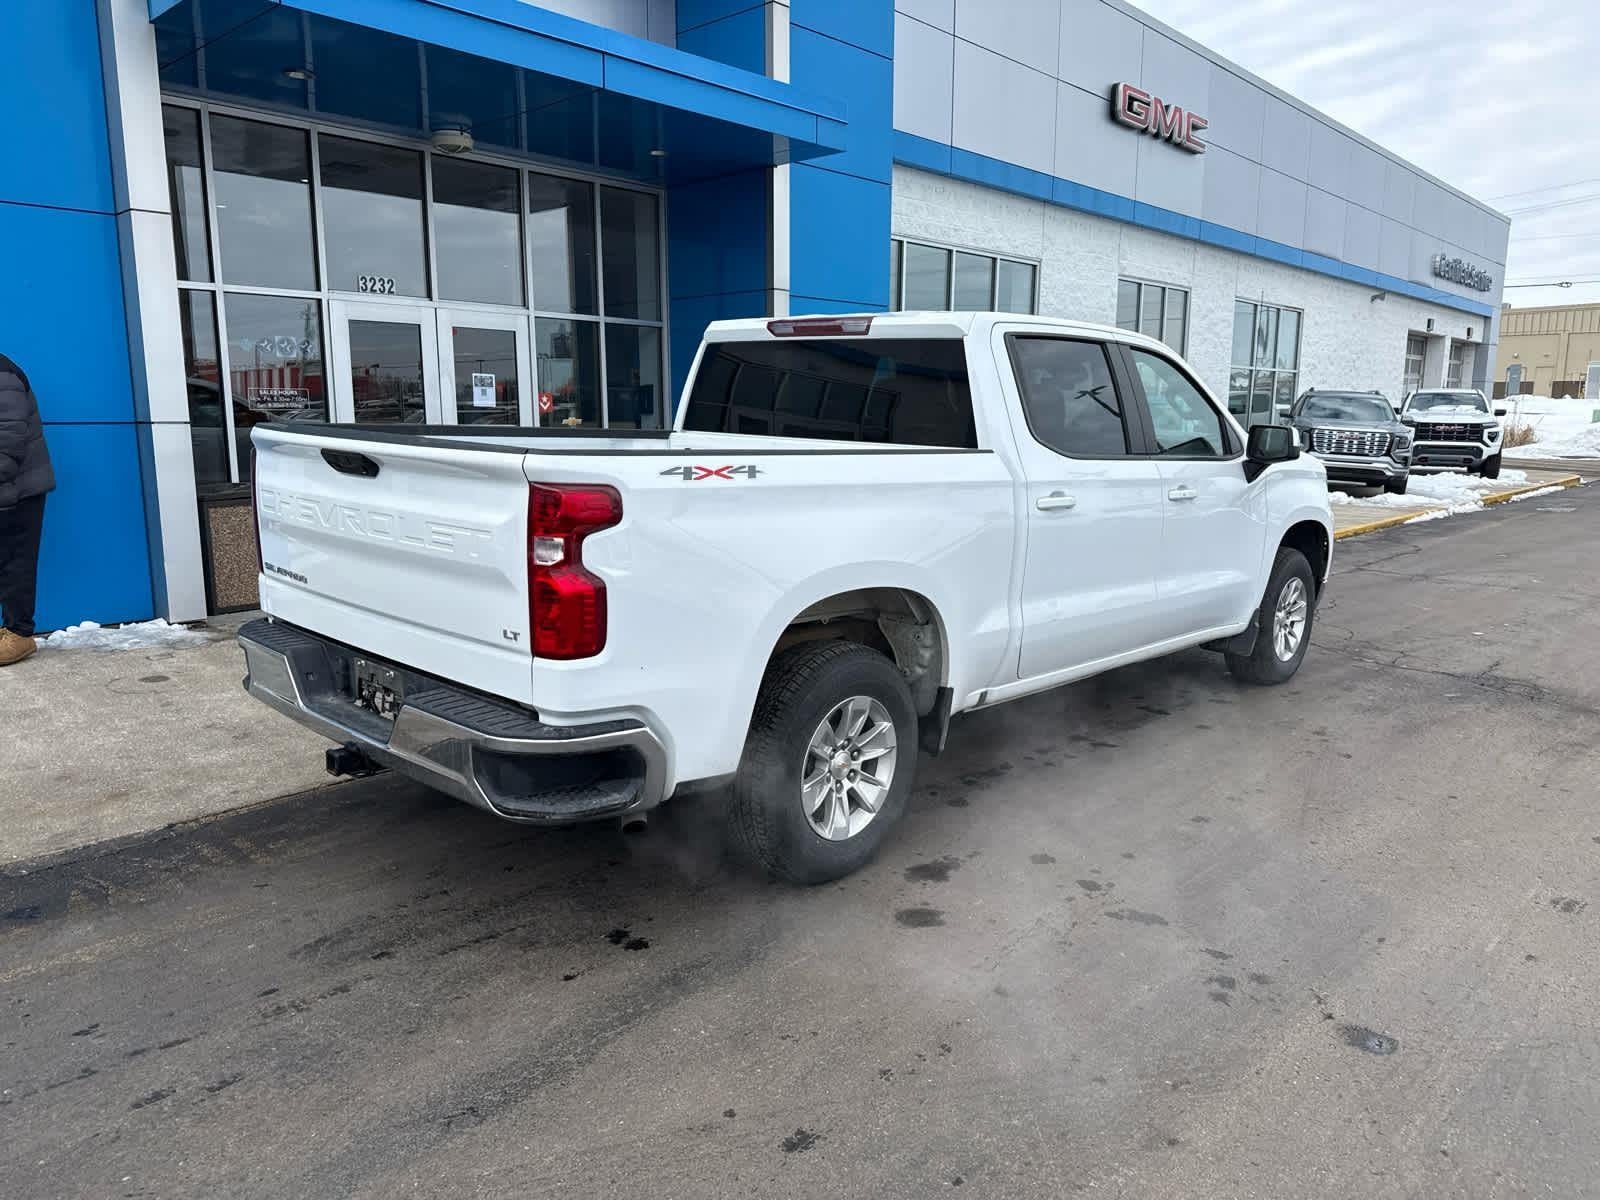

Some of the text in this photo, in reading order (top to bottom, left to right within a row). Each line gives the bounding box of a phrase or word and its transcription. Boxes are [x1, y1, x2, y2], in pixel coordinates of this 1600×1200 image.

[1114, 82, 1209, 153] GMC
[359, 276, 395, 294] 3232
[262, 488, 492, 558] CHEVROLET
[503, 629, 520, 641] LT
